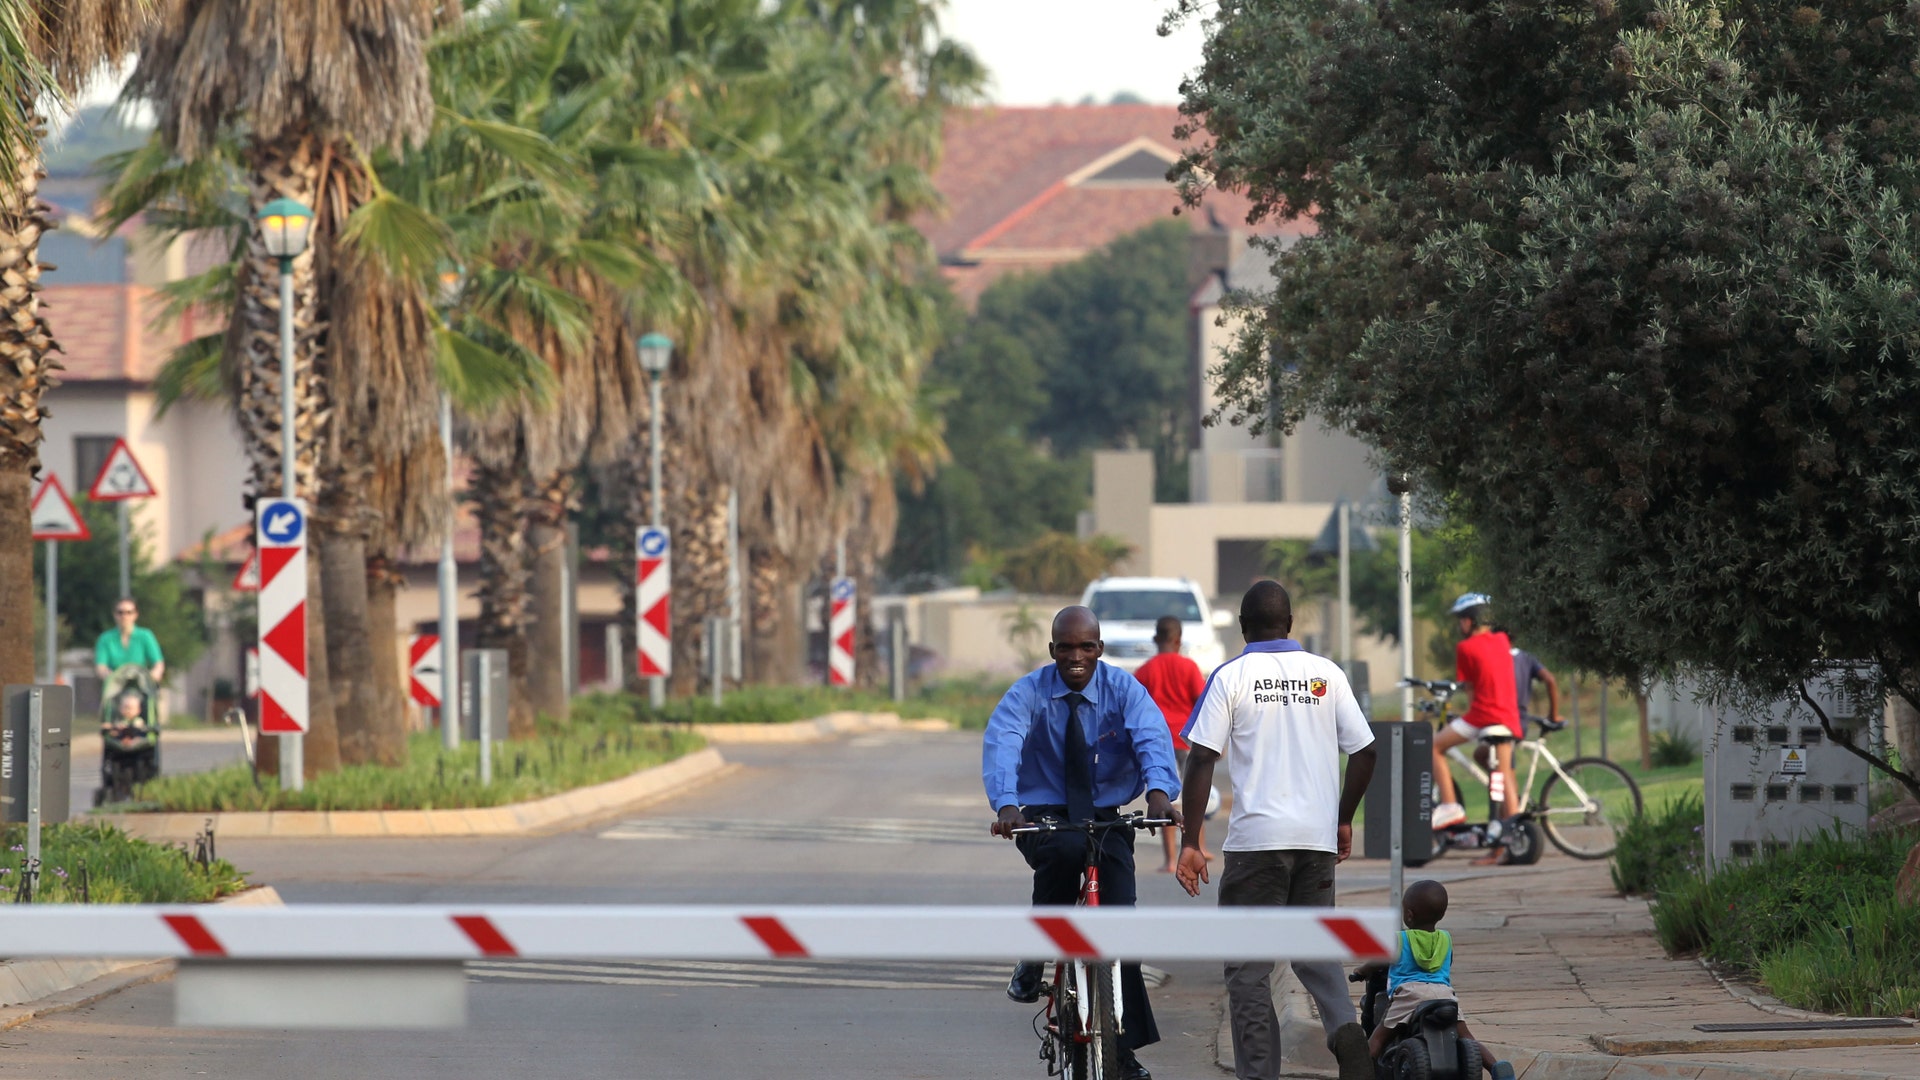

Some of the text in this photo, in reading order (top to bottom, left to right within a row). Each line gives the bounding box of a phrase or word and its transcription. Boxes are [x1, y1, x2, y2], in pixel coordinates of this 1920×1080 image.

[1254, 679, 1308, 691] ABARTH
[1254, 692, 1320, 706] Racing Team
